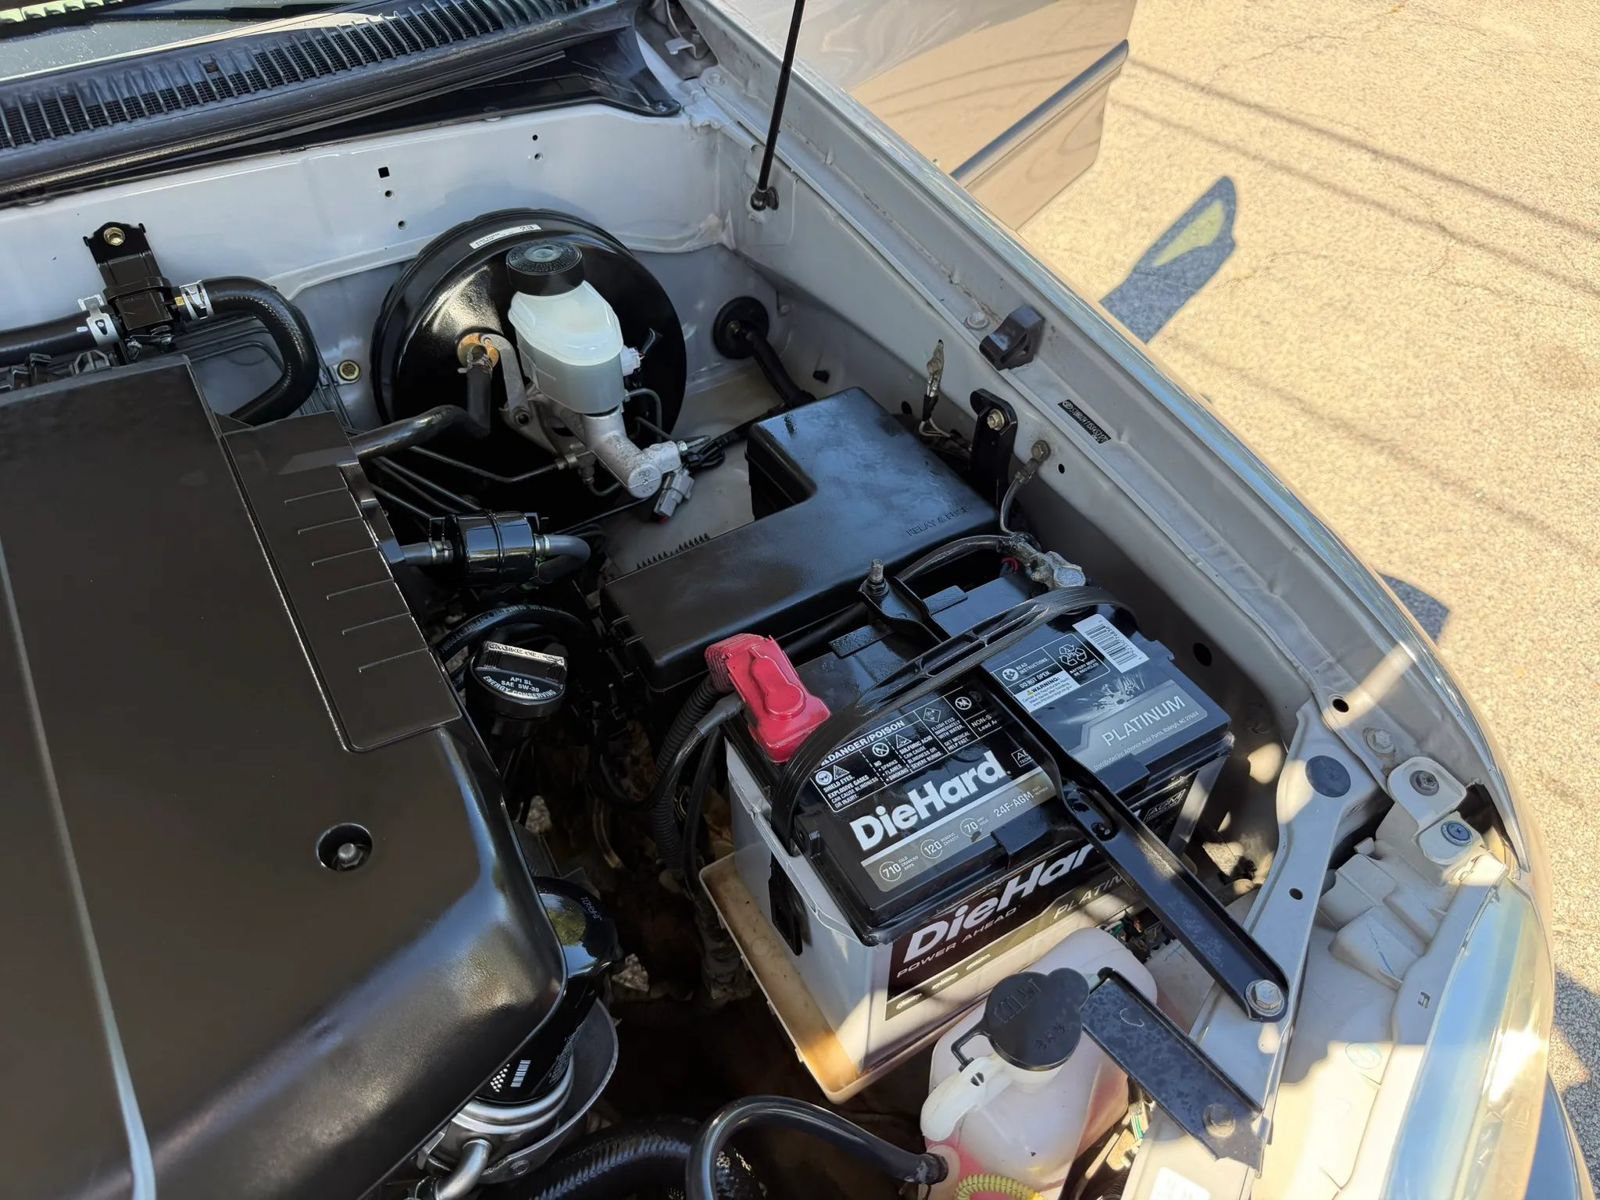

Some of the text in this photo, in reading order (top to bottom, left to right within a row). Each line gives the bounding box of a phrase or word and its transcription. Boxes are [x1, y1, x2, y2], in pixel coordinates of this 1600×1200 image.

[483, 675, 511, 695] ENERGY
[1102, 696, 1186, 745] PLATINUM
[850, 750, 1007, 851] DieHard
[992, 791, 1035, 817] 24F-AGM
[964, 821, 979, 833] 70
[924, 841, 943, 855] 120
[882, 863, 902, 878] 710
[903, 845, 1094, 963] DieHar
[1054, 875, 1123, 920] PLATIN
[897, 943, 957, 979] POWER
[962, 907, 1017, 943] AHEAD
